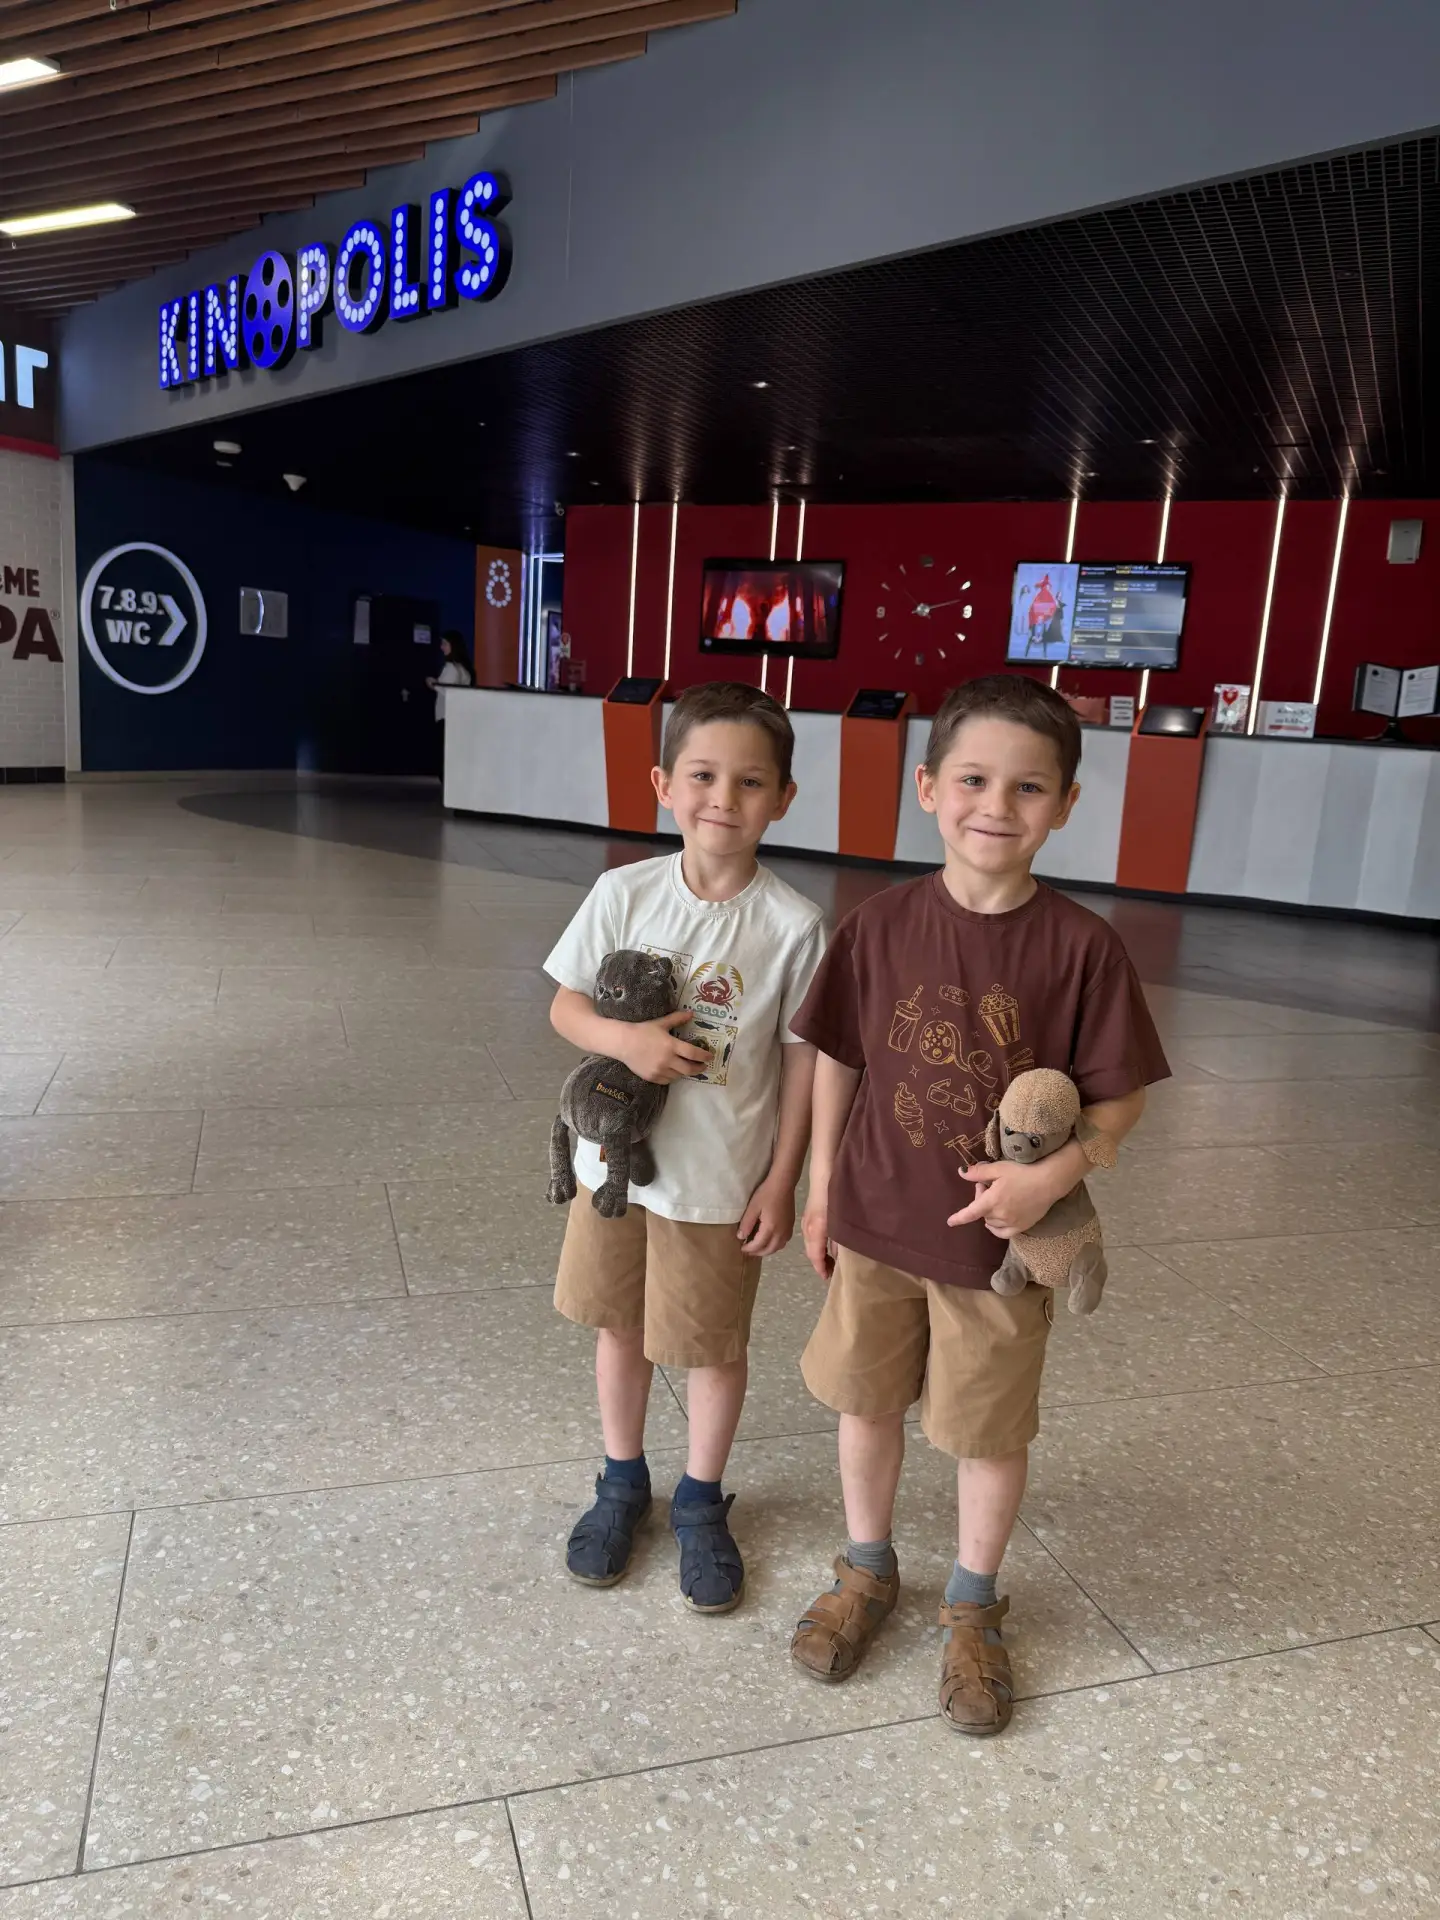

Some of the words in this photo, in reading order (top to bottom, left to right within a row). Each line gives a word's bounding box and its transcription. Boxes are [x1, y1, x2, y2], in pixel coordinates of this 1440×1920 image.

[159, 171, 508, 390] KINOPOLIS
[0, 566, 40, 598] ME
[485, 558, 513, 608] 8
[105, 618, 151, 645] WC
